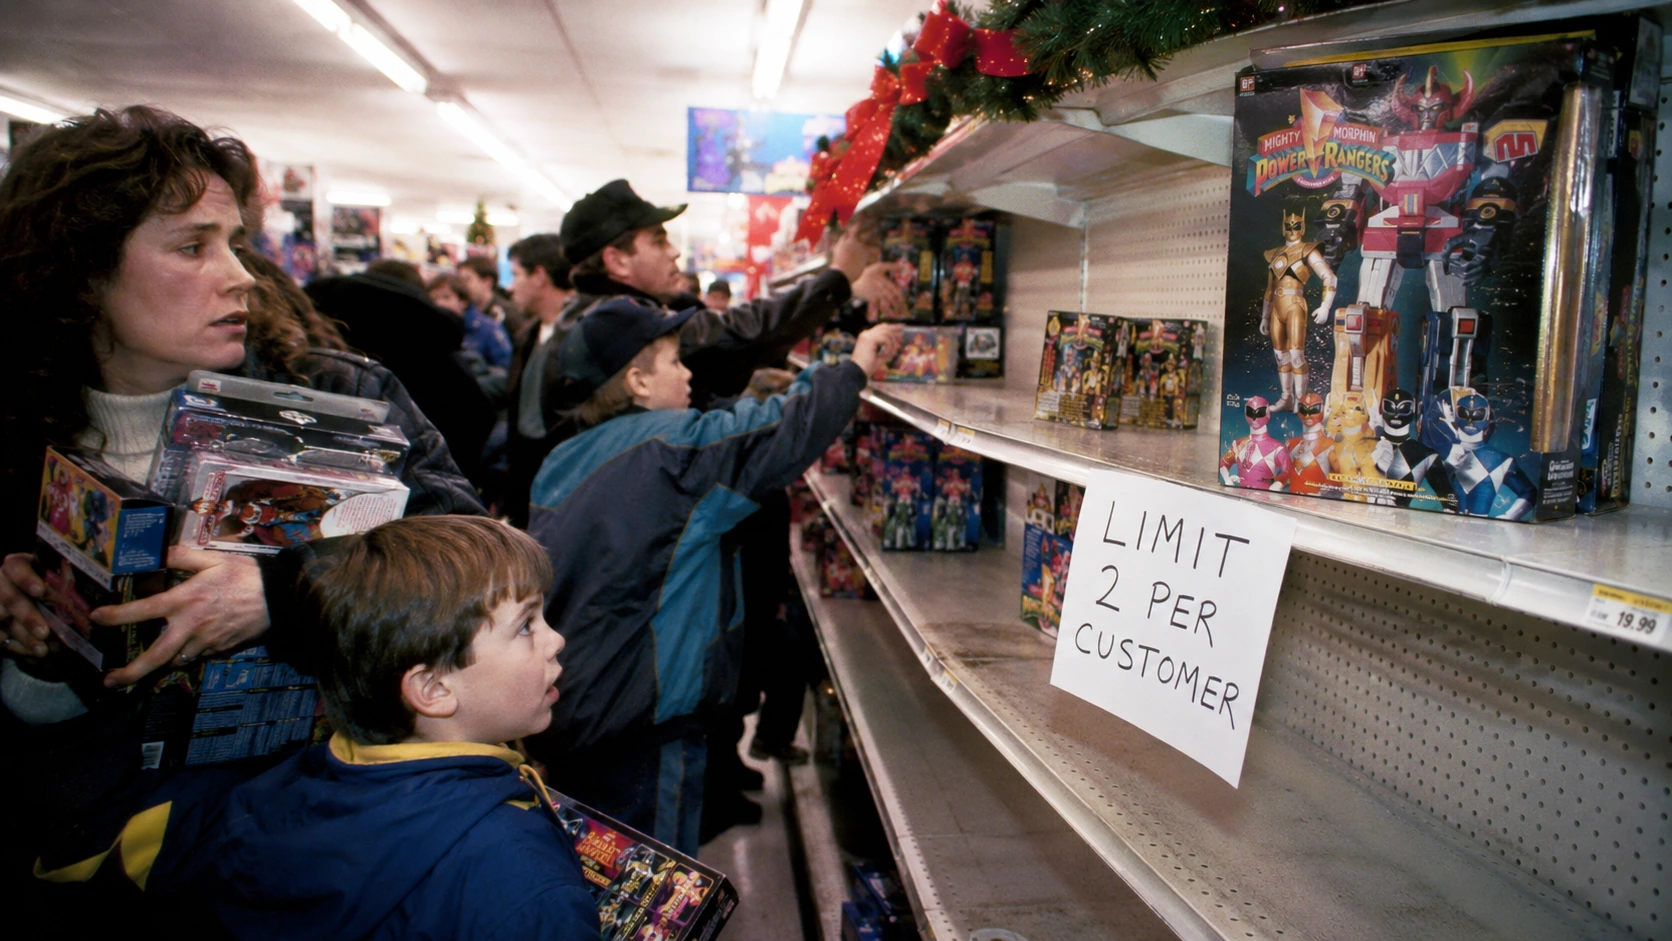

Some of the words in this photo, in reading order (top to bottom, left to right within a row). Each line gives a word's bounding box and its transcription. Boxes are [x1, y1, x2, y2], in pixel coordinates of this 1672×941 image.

[1255, 150, 1308, 197] POWER
[1324, 142, 1390, 182] RANGERS
[1264, 130, 1300, 151] MIGHTY
[1333, 127, 1376, 143] MORPHIN
[1102, 500, 1250, 578] LIMIT
[1095, 565, 1120, 612] 2
[1147, 581, 1217, 648] PER
[1617, 611, 1657, 635] 19.99
[1074, 622, 1240, 730] CUSTOMER
